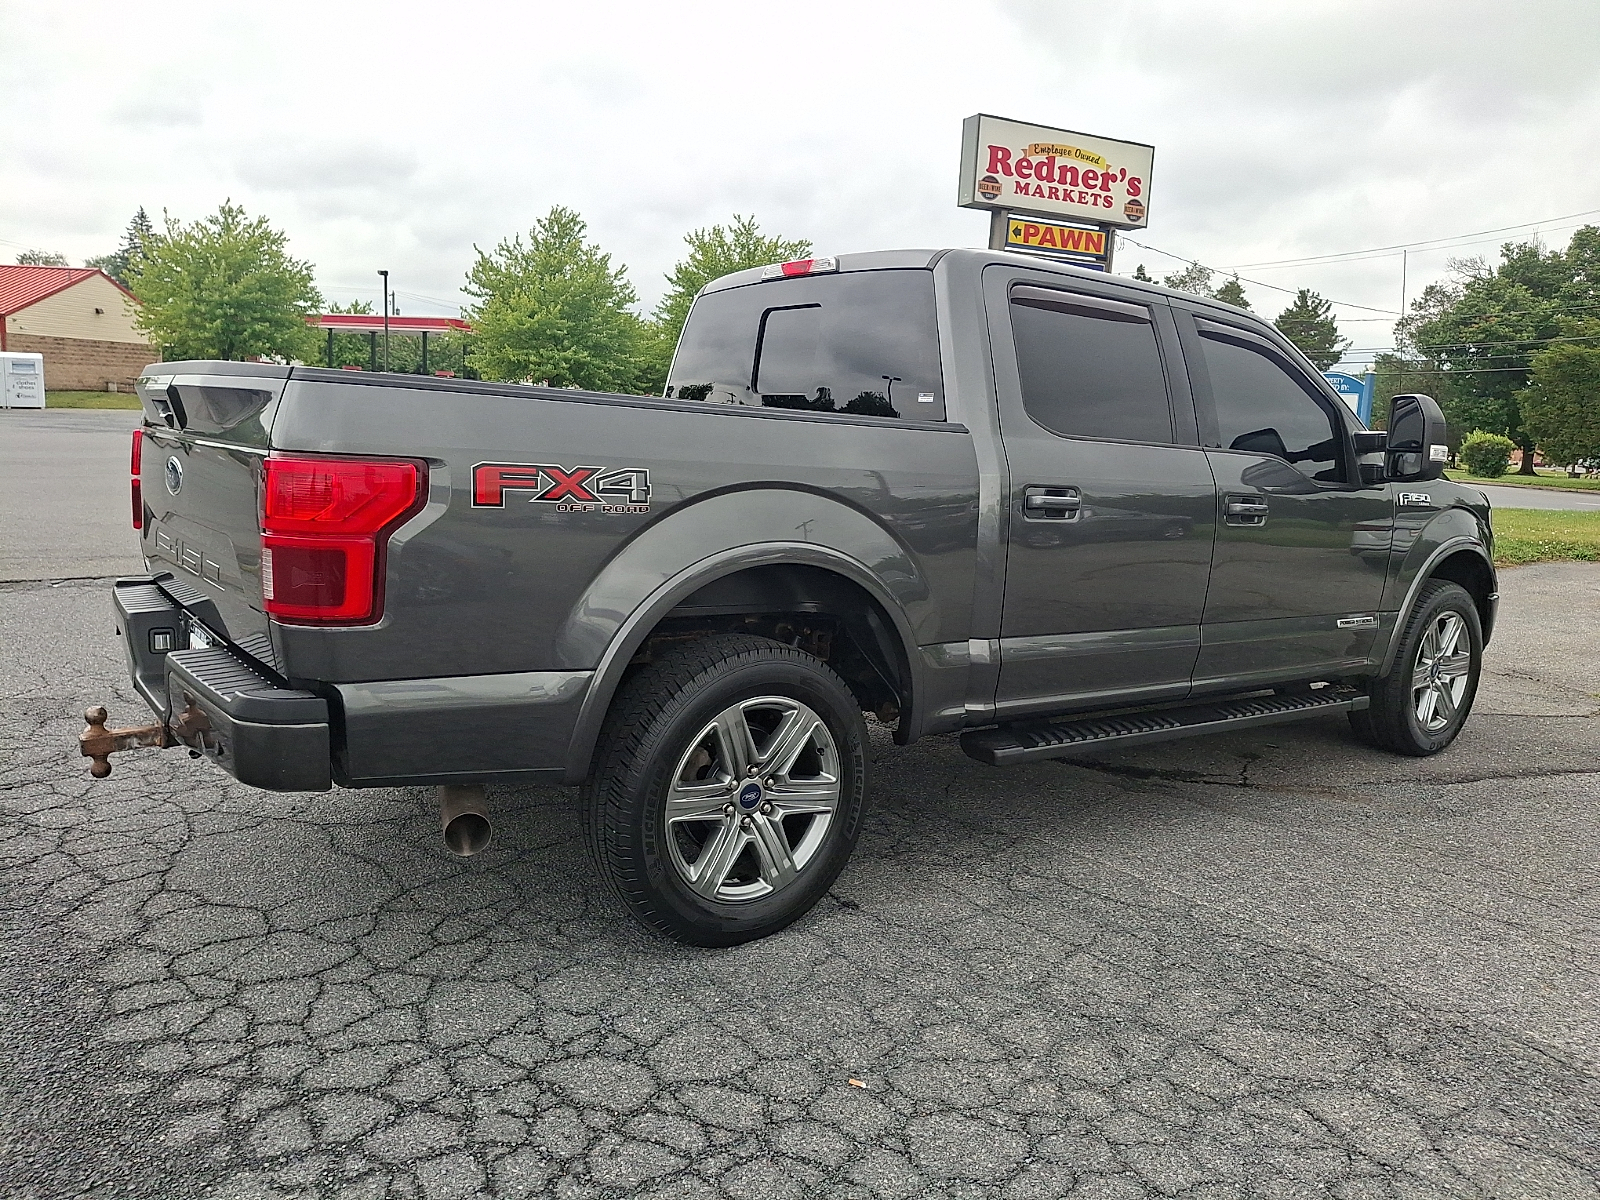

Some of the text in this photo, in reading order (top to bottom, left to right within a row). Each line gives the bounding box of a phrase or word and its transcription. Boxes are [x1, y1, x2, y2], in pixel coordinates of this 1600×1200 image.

[985, 144, 1142, 198] Redner's
[1033, 143, 1101, 165] Employee Owned
[1013, 180, 1114, 209] MARKETS
[1022, 223, 1103, 253] PAWN
[470, 460, 652, 509] FX4
[556, 503, 651, 514] OFF ROAD
[645, 764, 665, 856] MICHELIN
[844, 753, 864, 838] MICHELIN
